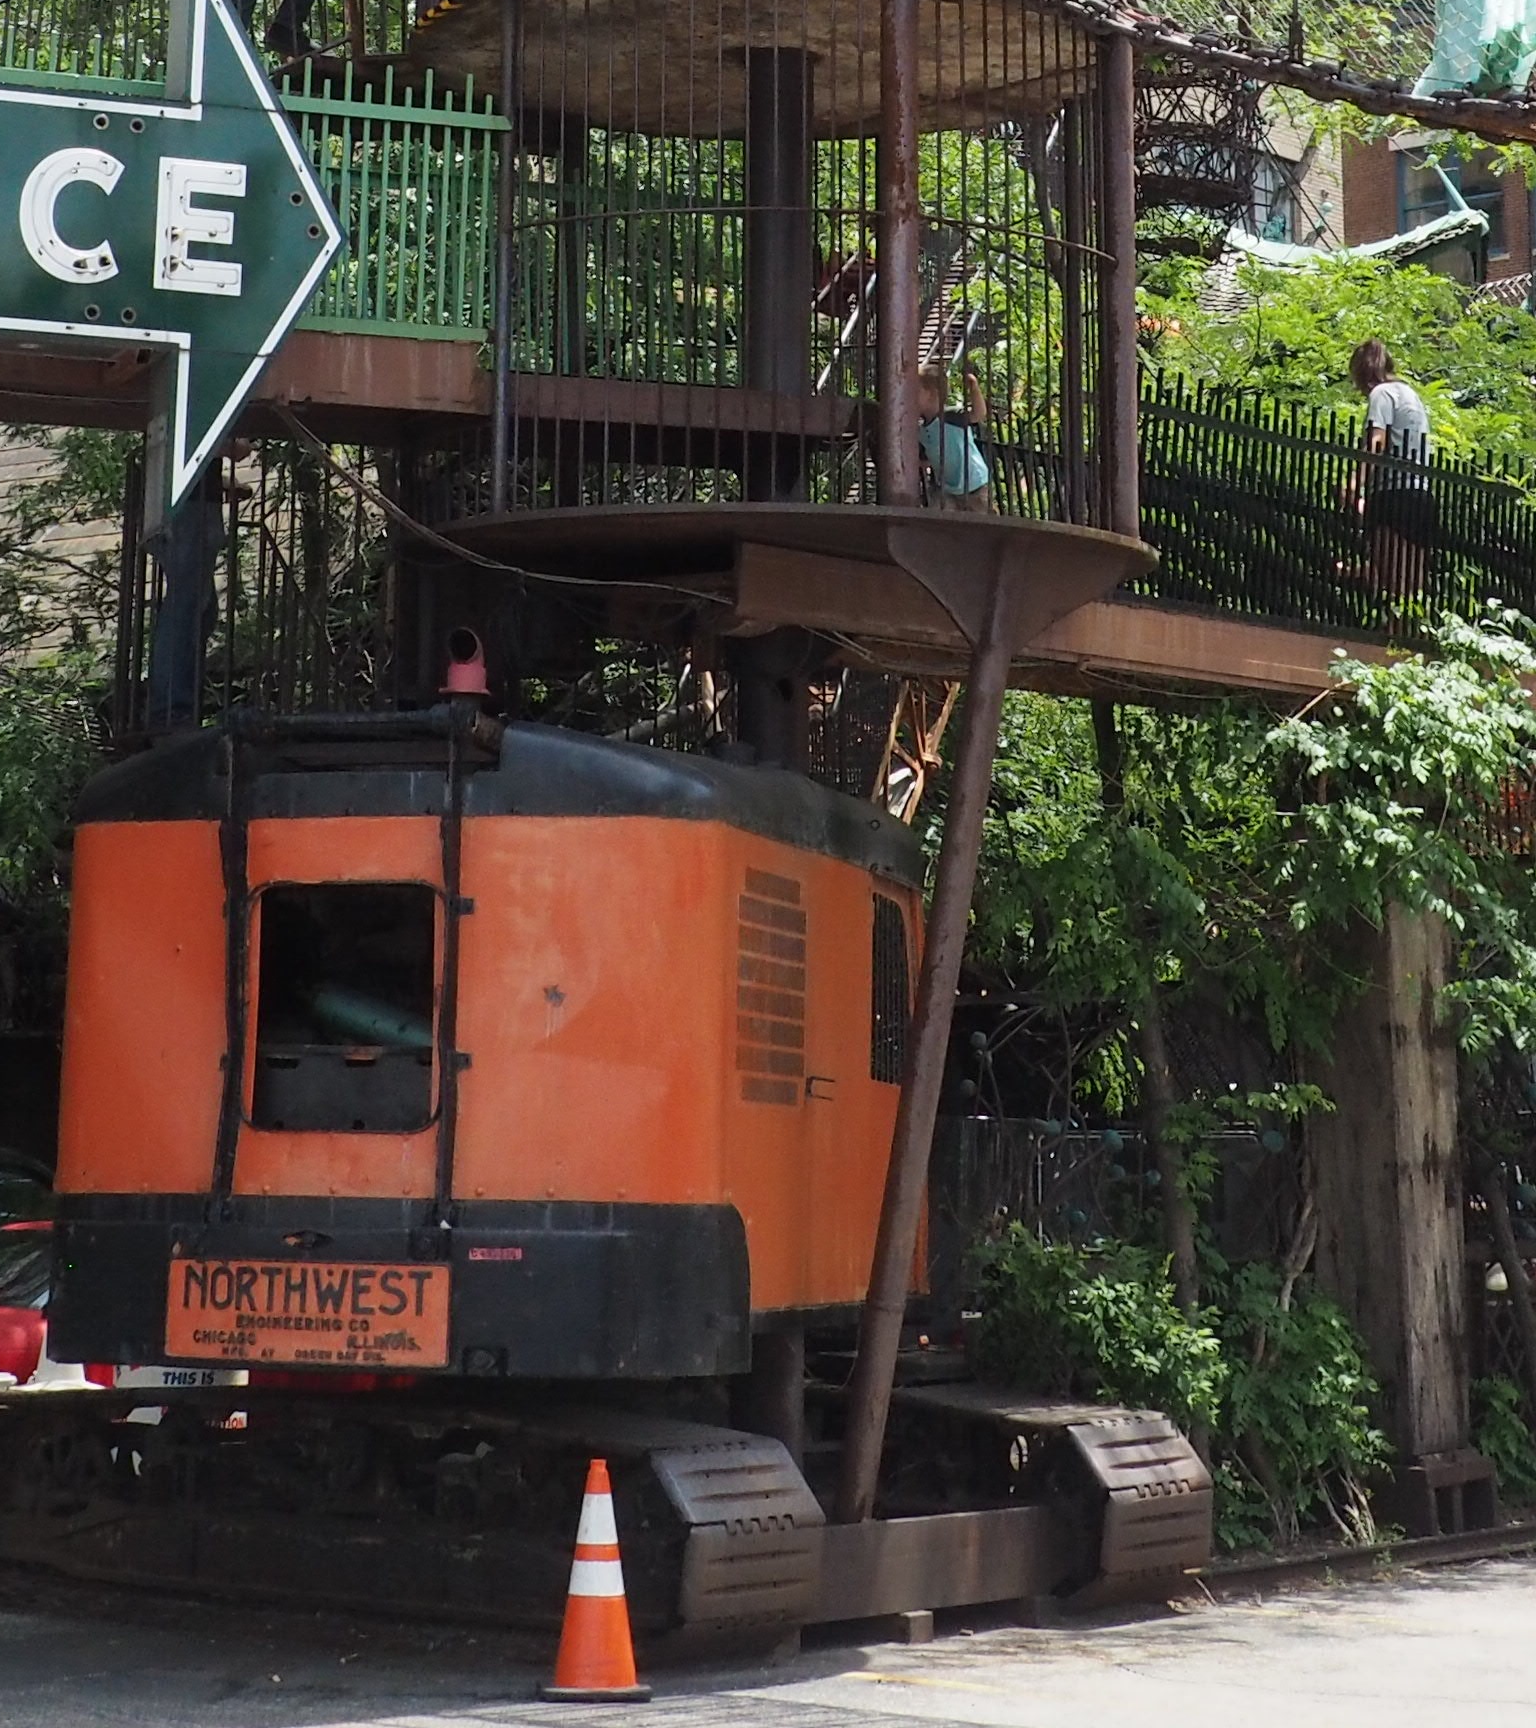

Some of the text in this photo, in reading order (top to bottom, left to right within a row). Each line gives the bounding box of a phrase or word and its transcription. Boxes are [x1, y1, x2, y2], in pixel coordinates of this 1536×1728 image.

[182, 1264, 434, 1318] NORTHWEST
[235, 1313, 370, 1332] ENGINEERING CO
[193, 1329, 256, 1346] CHICAGO
[162, 1371, 214, 1385] THIS IS
